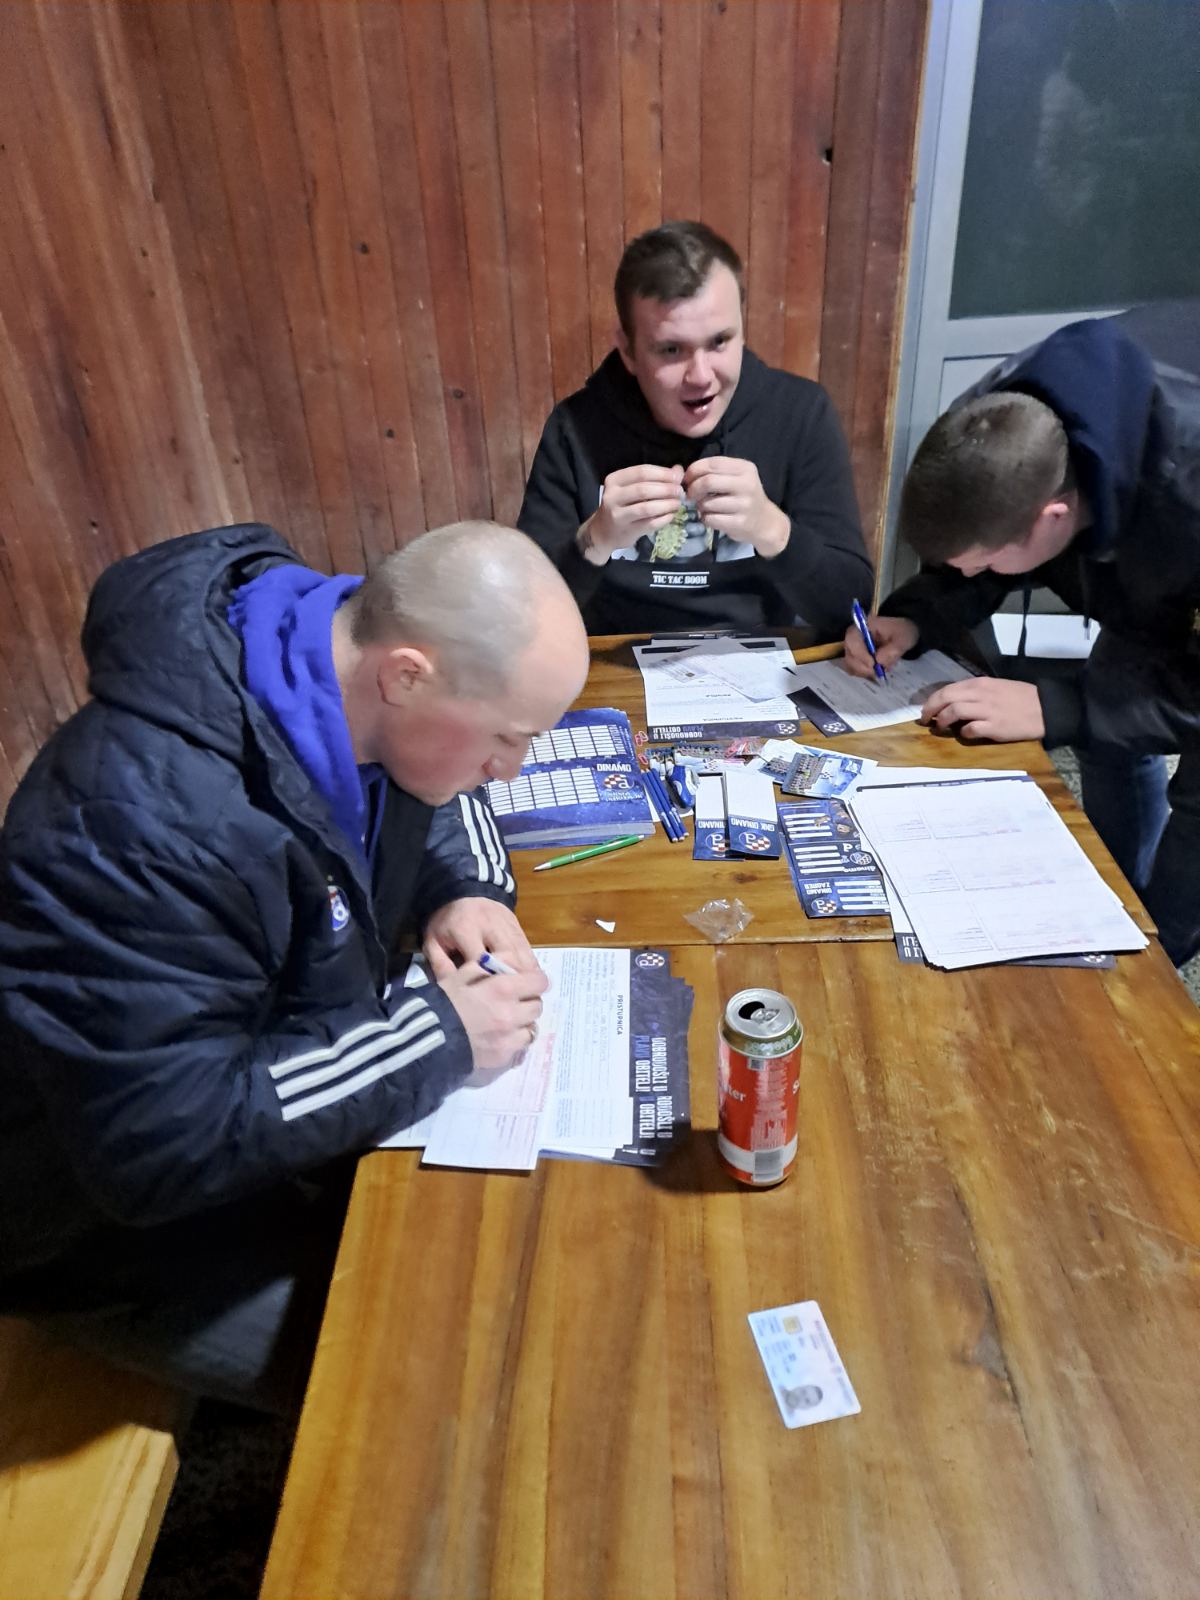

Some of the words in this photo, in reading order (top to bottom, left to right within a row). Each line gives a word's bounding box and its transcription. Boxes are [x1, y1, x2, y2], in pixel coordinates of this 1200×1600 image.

[653, 575, 667, 584] TIC
[668, 575, 684, 584] TAC
[596, 763, 632, 772] DINAMO
[731, 818, 759, 830] DINAMO
[616, 994, 624, 1036] PRISTUPNICA
[635, 1035, 650, 1058] PLAVU
[652, 1037, 670, 1084] DOBRODOŠLI
[656, 1096, 675, 1129] RODOŠLI
